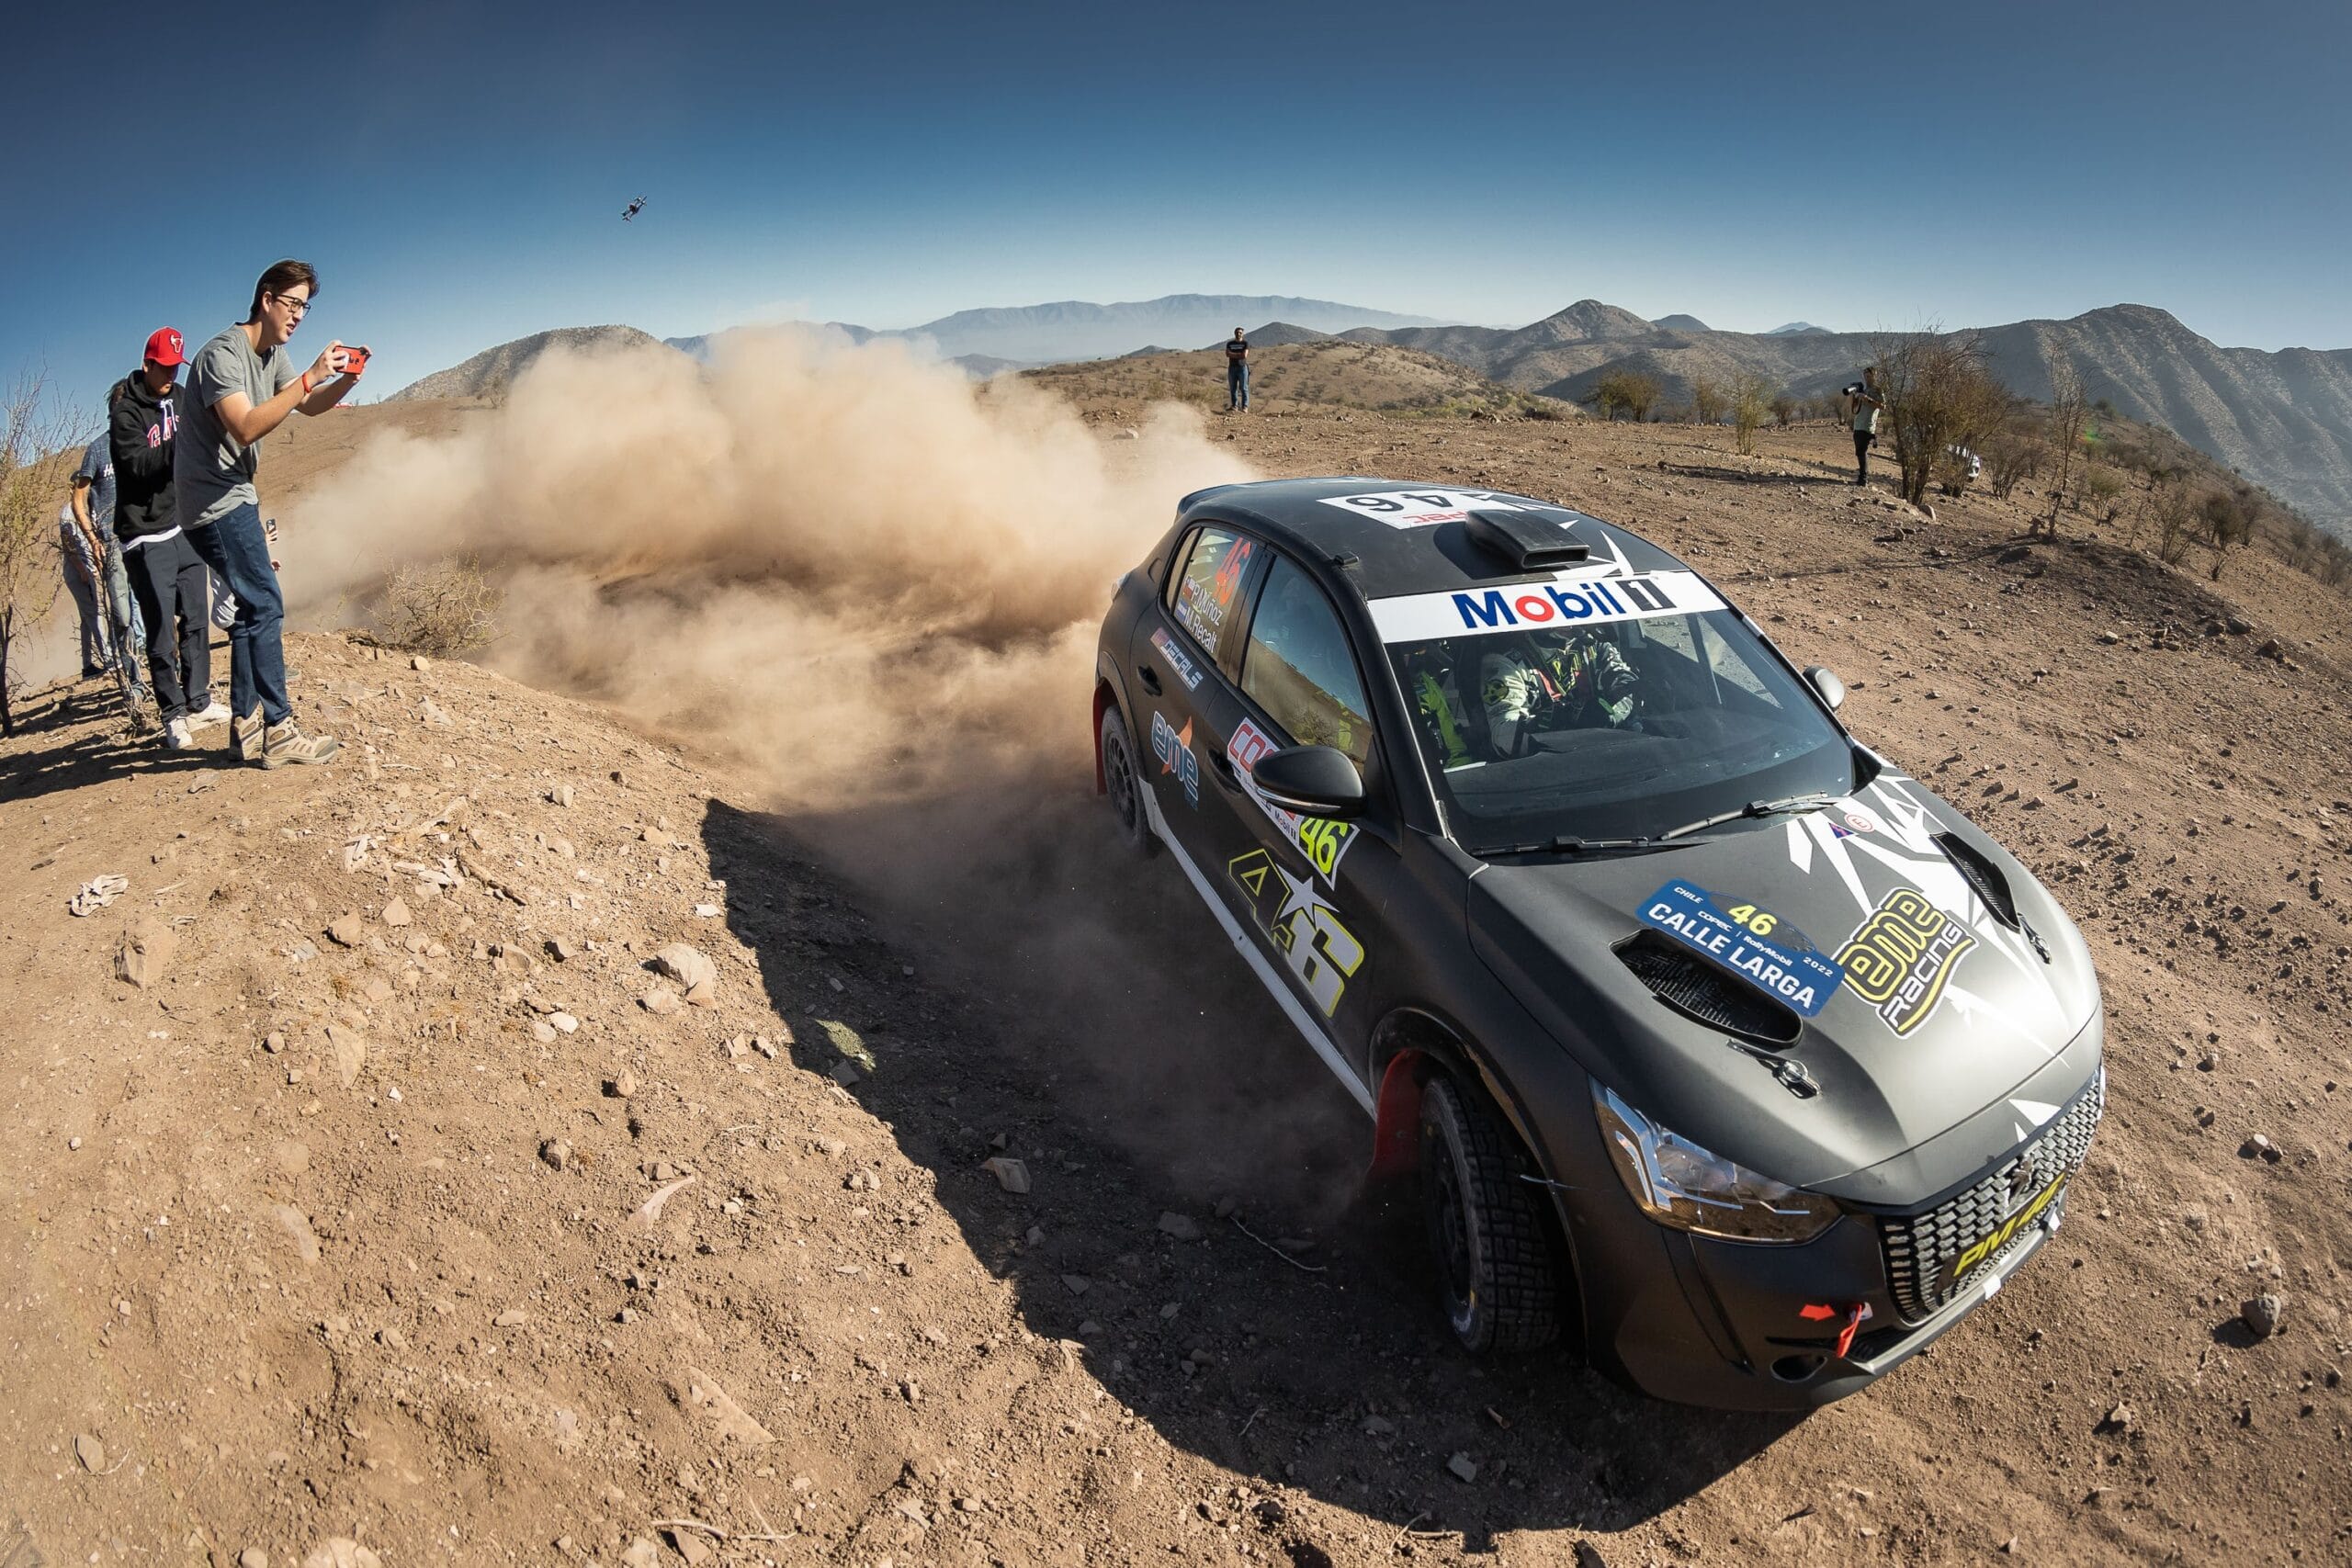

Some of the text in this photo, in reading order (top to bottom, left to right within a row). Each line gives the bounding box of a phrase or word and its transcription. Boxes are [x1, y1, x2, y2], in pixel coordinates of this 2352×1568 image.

[1346, 493, 1453, 512] 46
[1213, 536, 1251, 606] 46
[1451, 579, 1669, 629] Mobil 1
[1160, 639, 1204, 689] DECALS
[1300, 818, 1349, 874] 46
[1673, 886, 1704, 904] CHILE
[1743, 935, 1793, 967] RallyMobil
[1803, 956, 1834, 978] 2022
[1728, 904, 1778, 936] 46
[1648, 903, 1815, 1010] CALLE LARGA
[1953, 1216, 2018, 1277] PM
